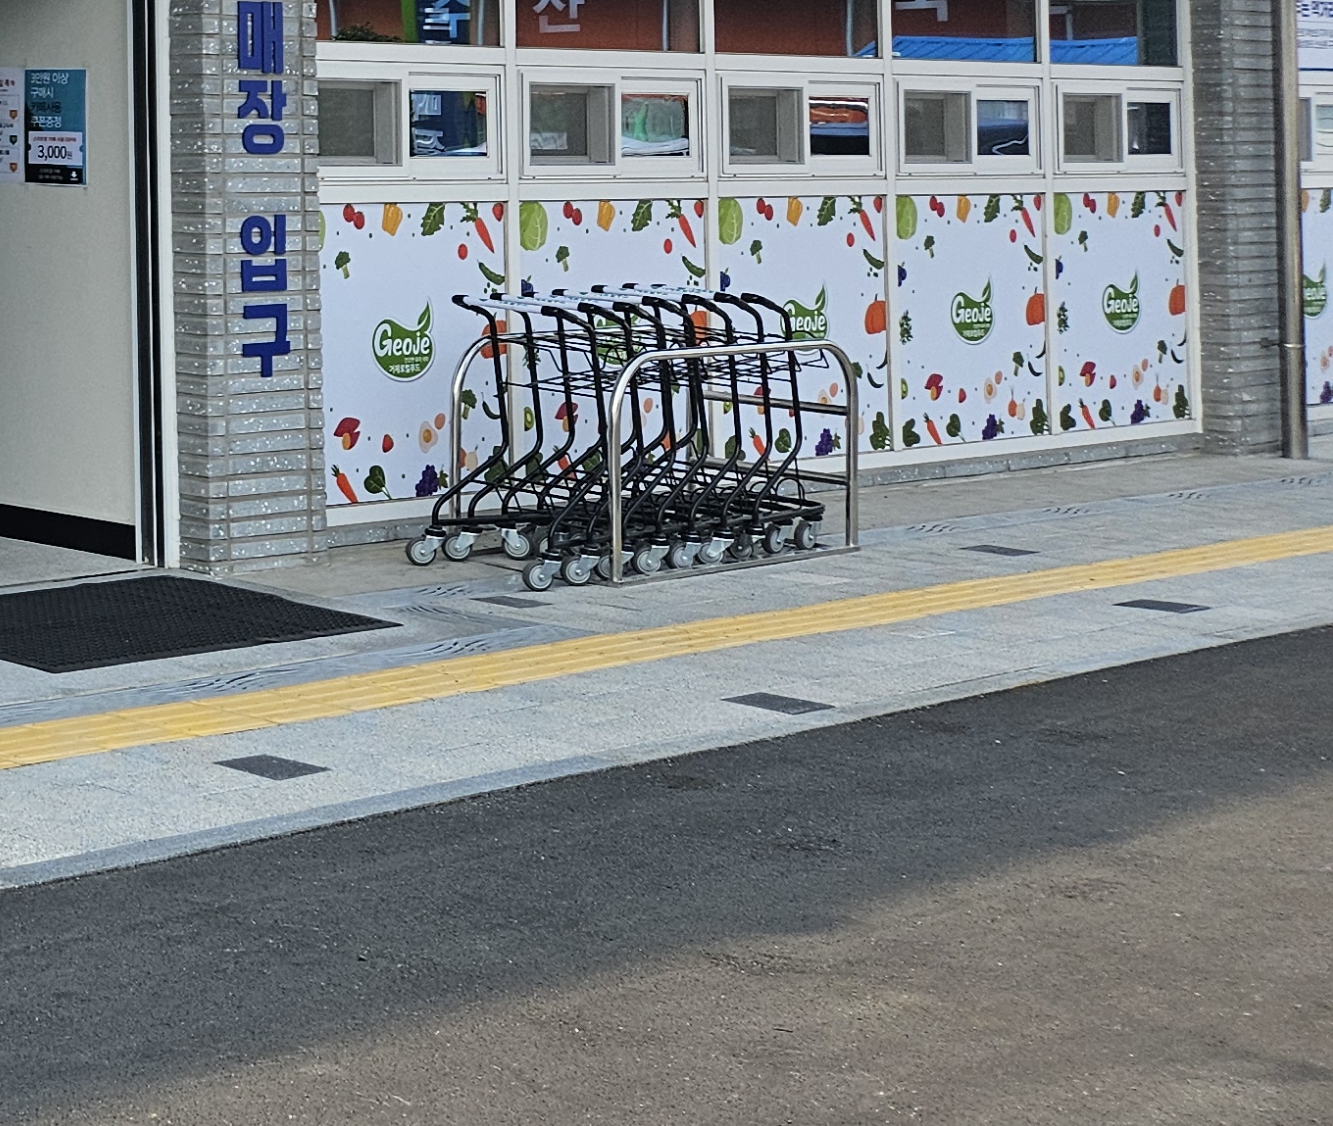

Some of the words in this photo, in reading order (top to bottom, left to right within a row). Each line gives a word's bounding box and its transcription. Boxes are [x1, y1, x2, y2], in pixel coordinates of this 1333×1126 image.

[52, 72, 69, 84] 이상
[240, 214, 290, 378] 입구
[953, 296, 992, 323] Geoje
[1104, 290, 1139, 314] Geoje
[373, 322, 430, 357] Geoje
